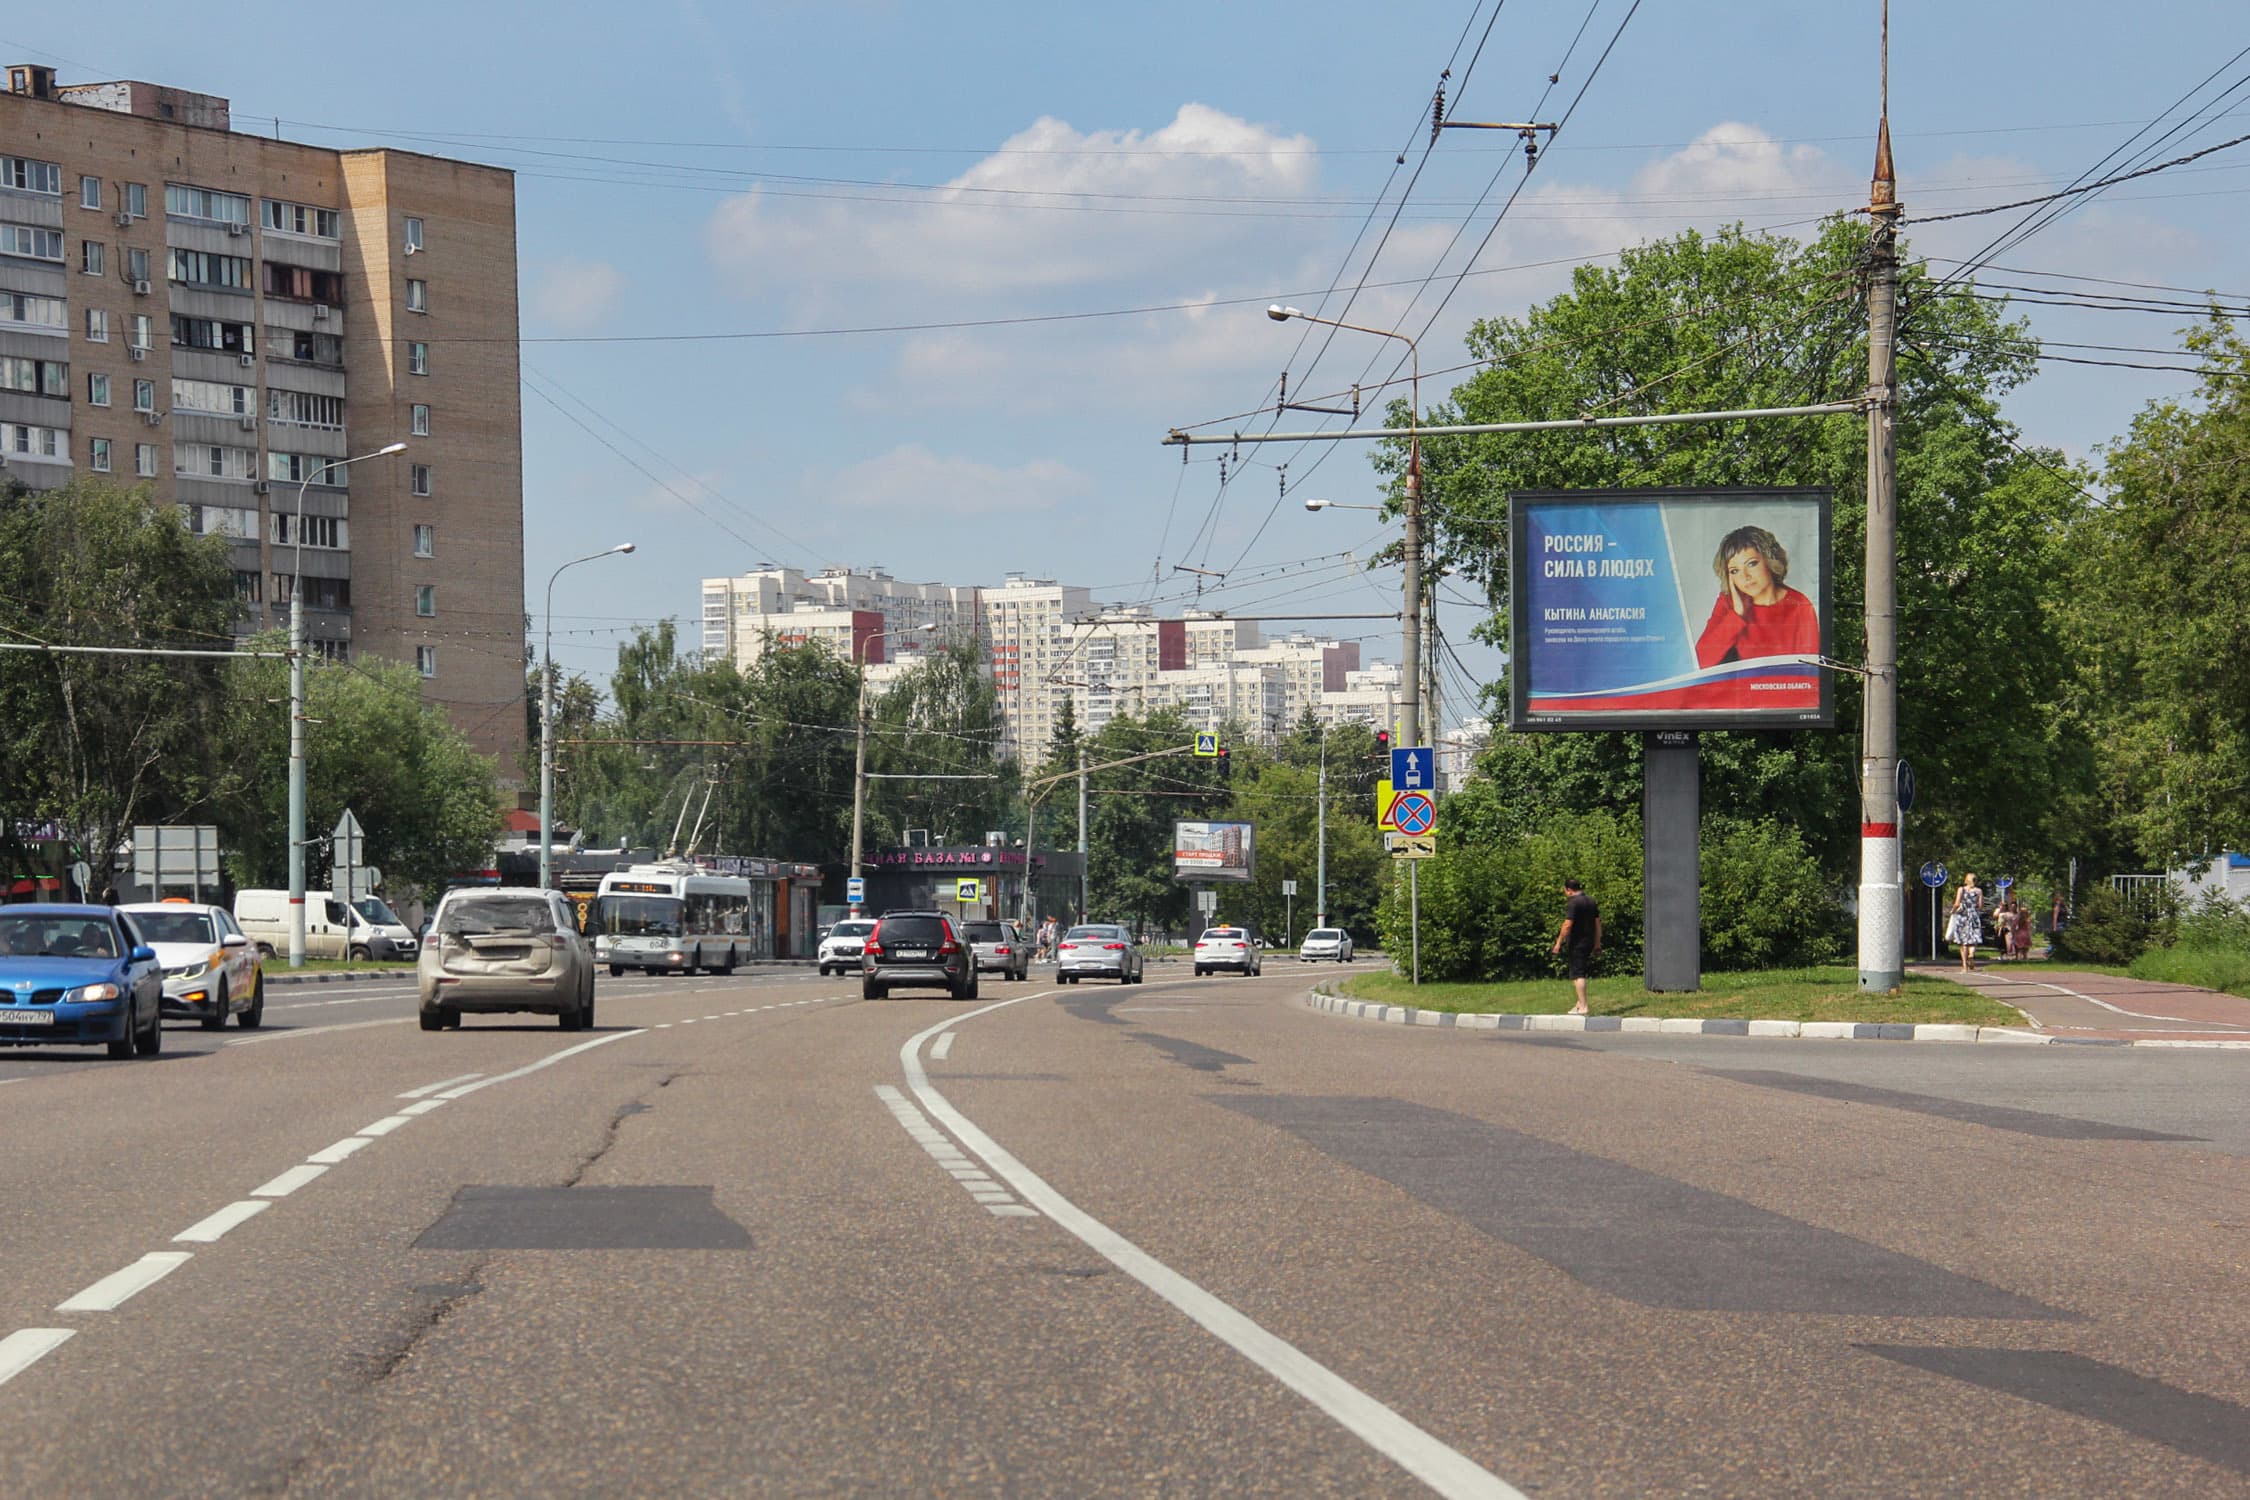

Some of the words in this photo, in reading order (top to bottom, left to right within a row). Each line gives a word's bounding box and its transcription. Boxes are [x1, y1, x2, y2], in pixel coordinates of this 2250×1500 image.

[1544, 535, 1603, 553] РОССИЯ
[1544, 560, 1584, 578] СИЛА
[1587, 560, 1597, 577] В
[1599, 559, 1655, 579] ЛЮДЯХ
[1544, 608, 1586, 621] КЫТИНА
[1589, 607, 1646, 620] АНАСТАСИЯ
[914, 852, 955, 864] БАЗА
